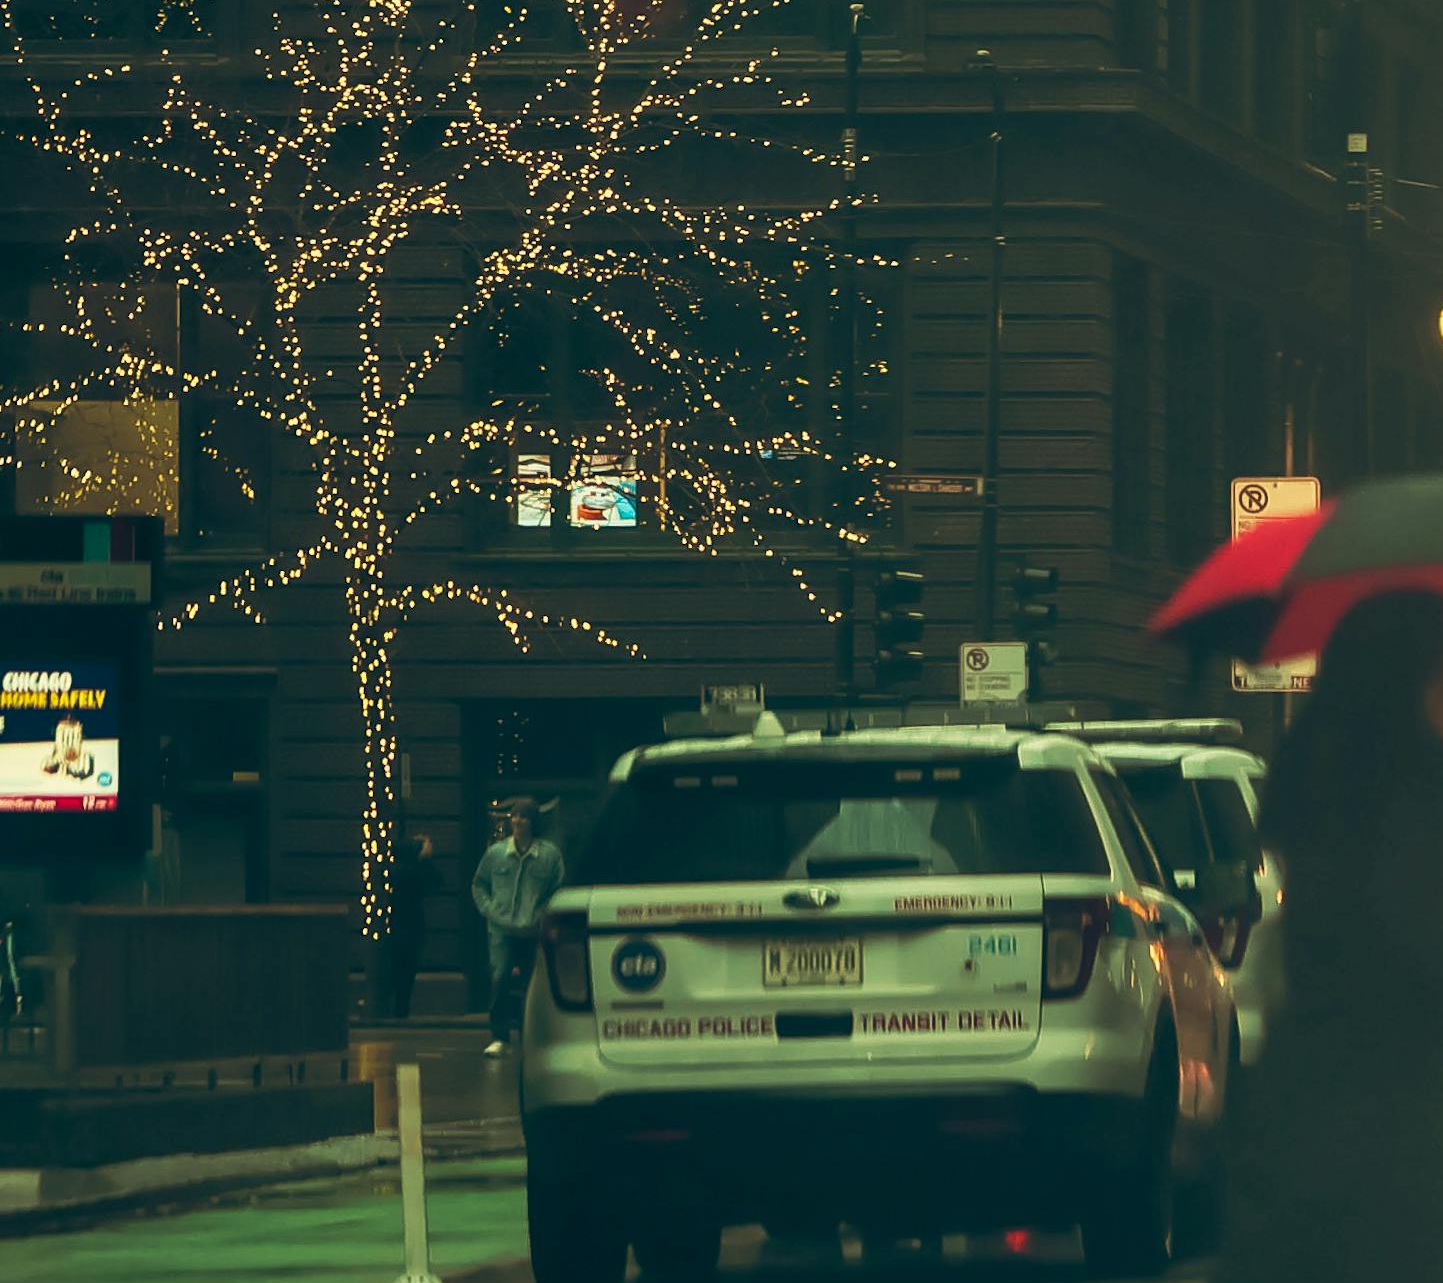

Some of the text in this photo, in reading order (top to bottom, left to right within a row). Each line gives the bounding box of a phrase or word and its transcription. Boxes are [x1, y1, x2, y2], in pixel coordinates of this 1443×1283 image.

[3, 671, 72, 694] CHICAGO
[50, 689, 106, 709] SAFELY
[620, 953, 658, 978] cta
[602, 1015, 774, 1040] CHICAGO POLICE
[860, 1009, 1028, 1035] TRANSIT DETAIL
